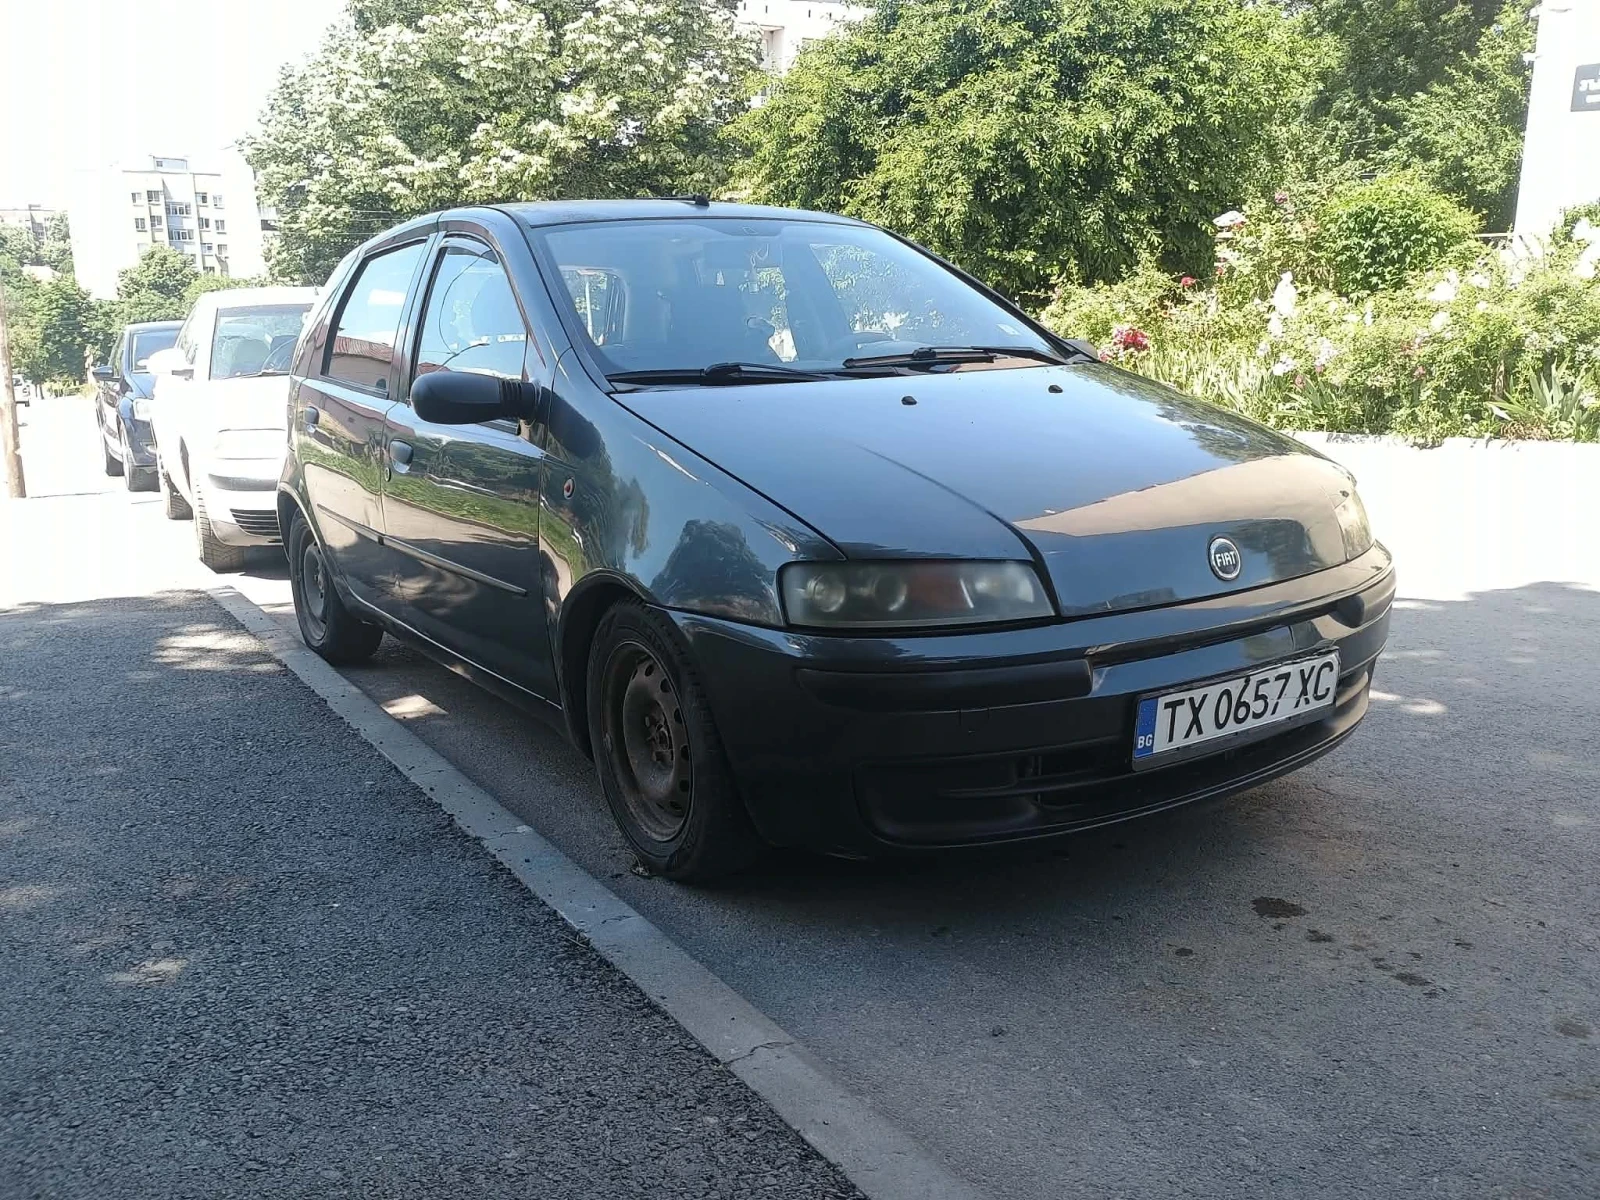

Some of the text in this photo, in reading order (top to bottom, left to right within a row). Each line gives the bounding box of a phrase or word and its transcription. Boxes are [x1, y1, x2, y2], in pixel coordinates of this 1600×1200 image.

[1215, 551, 1236, 567] FIAT
[1164, 661, 1334, 743] TX 0657 XC
[1137, 734, 1153, 749] BG
